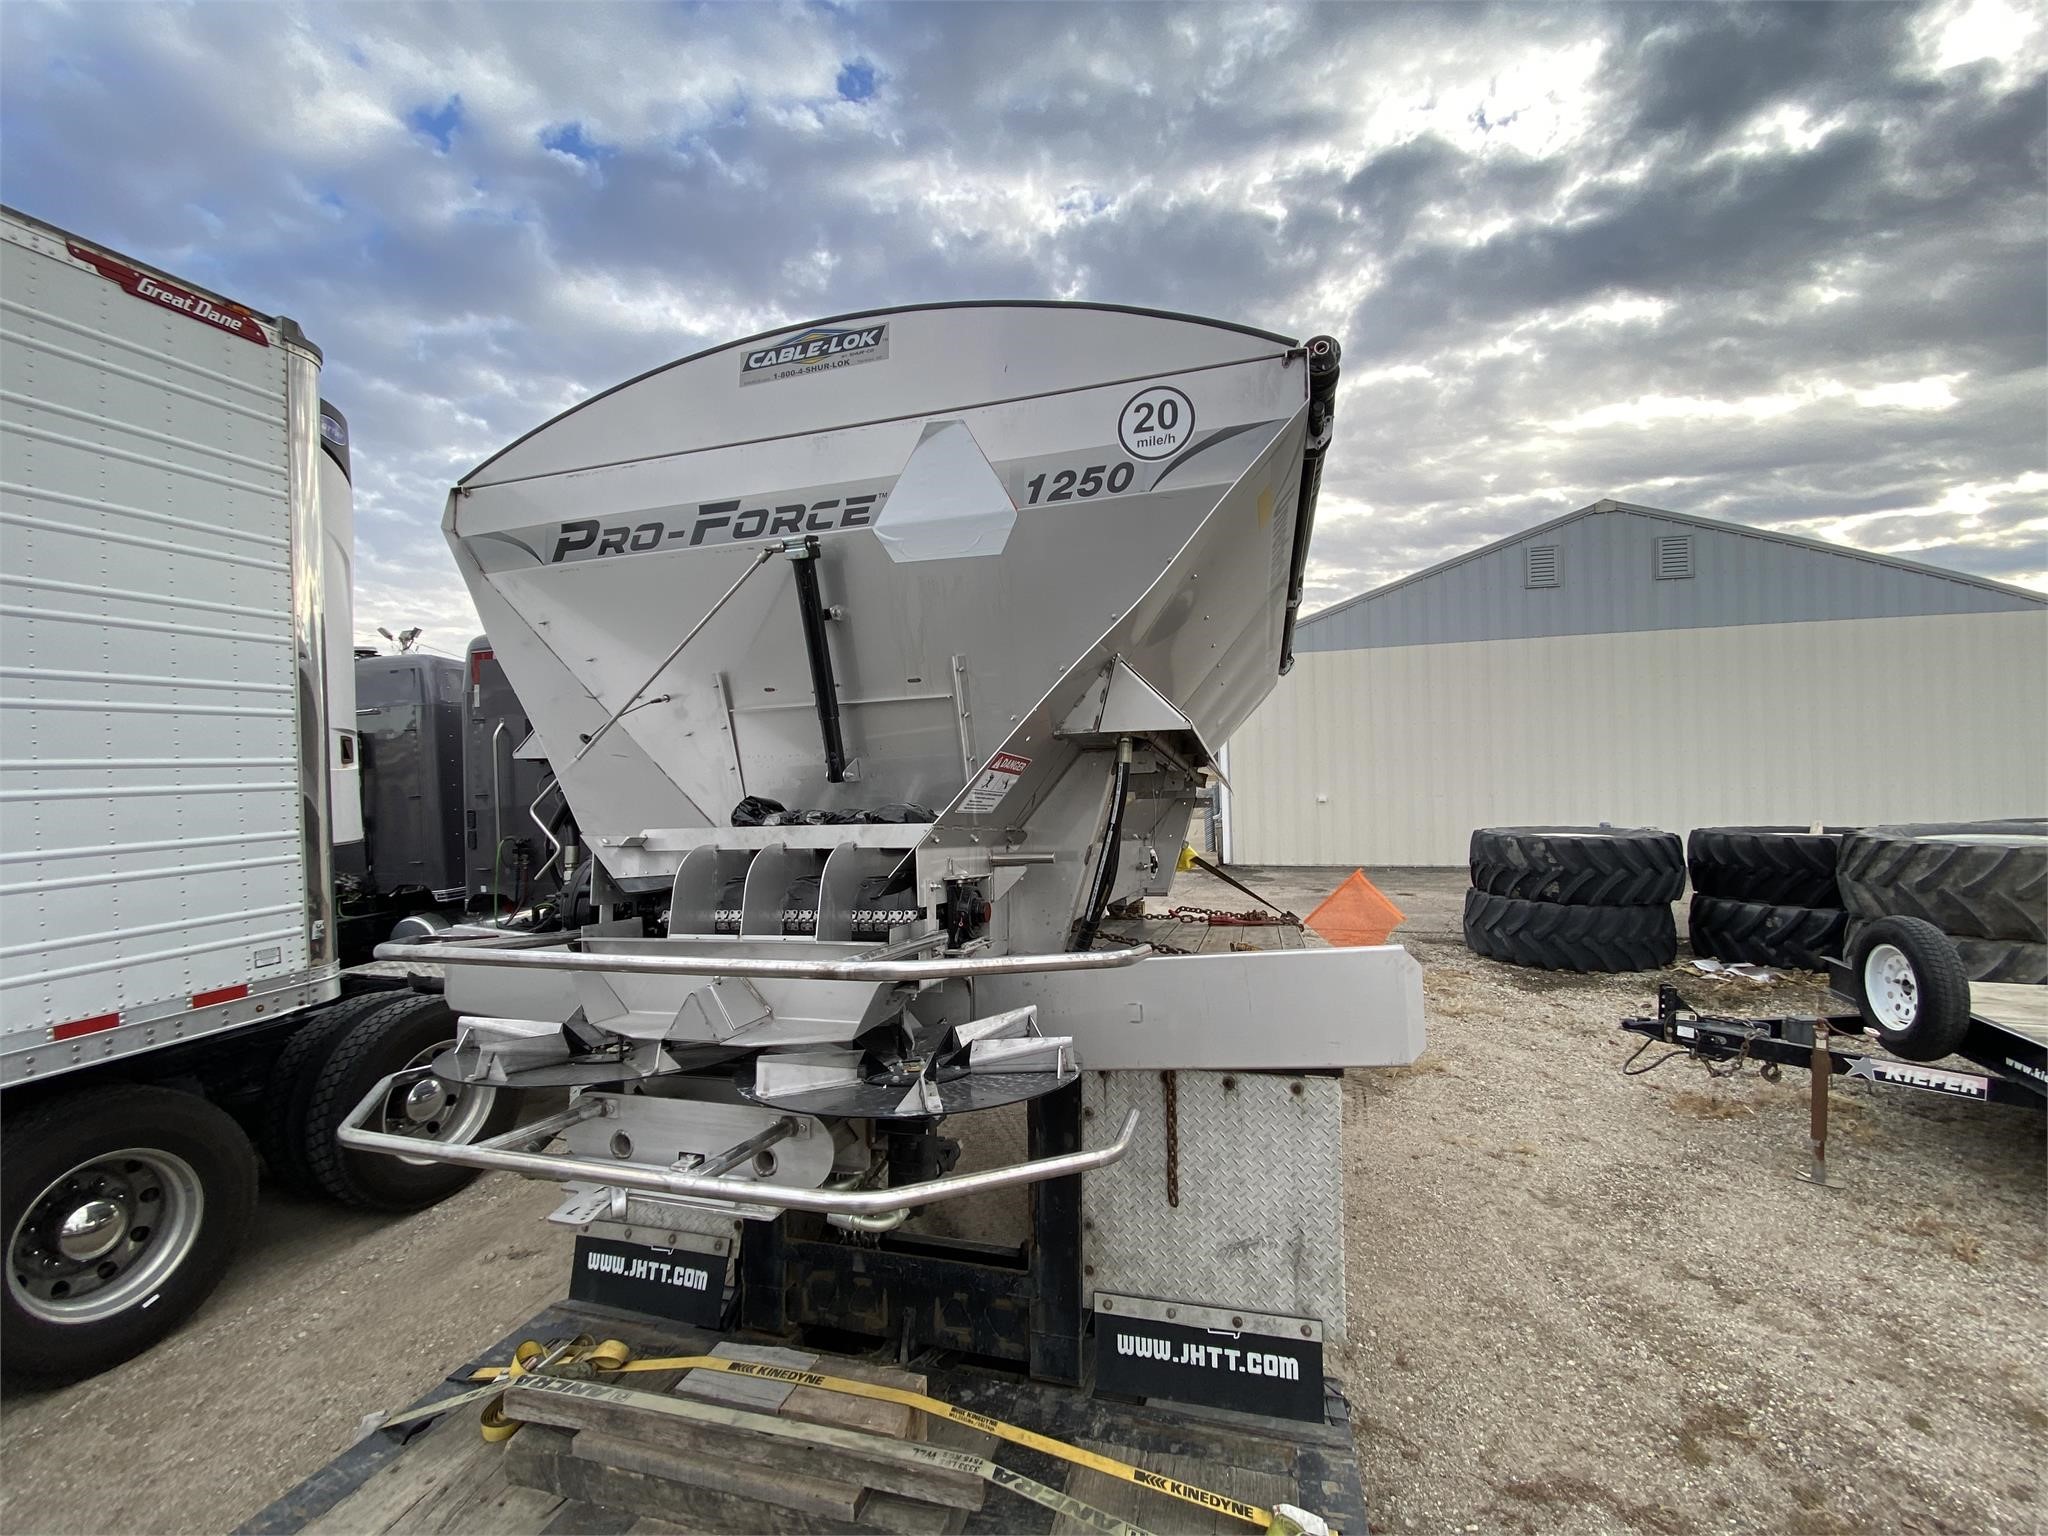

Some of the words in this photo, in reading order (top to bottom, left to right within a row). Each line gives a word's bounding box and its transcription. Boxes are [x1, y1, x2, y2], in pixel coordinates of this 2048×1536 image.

[137, 278, 194, 312] Great
[193, 300, 242, 331] Dane
[748, 329, 879, 369] CABLE-LOK
[773, 358, 850, 380] 1-800-4-SHUR-LOK
[1133, 399, 1178, 434] 20
[1136, 433, 1176, 448] mile/h
[1027, 461, 1135, 505] 1250
[1885, 1067, 1978, 1095] KIEFER
[756, 1365, 825, 1385] KINEDYNE
[1170, 1481, 1254, 1519] KINEDYNE
